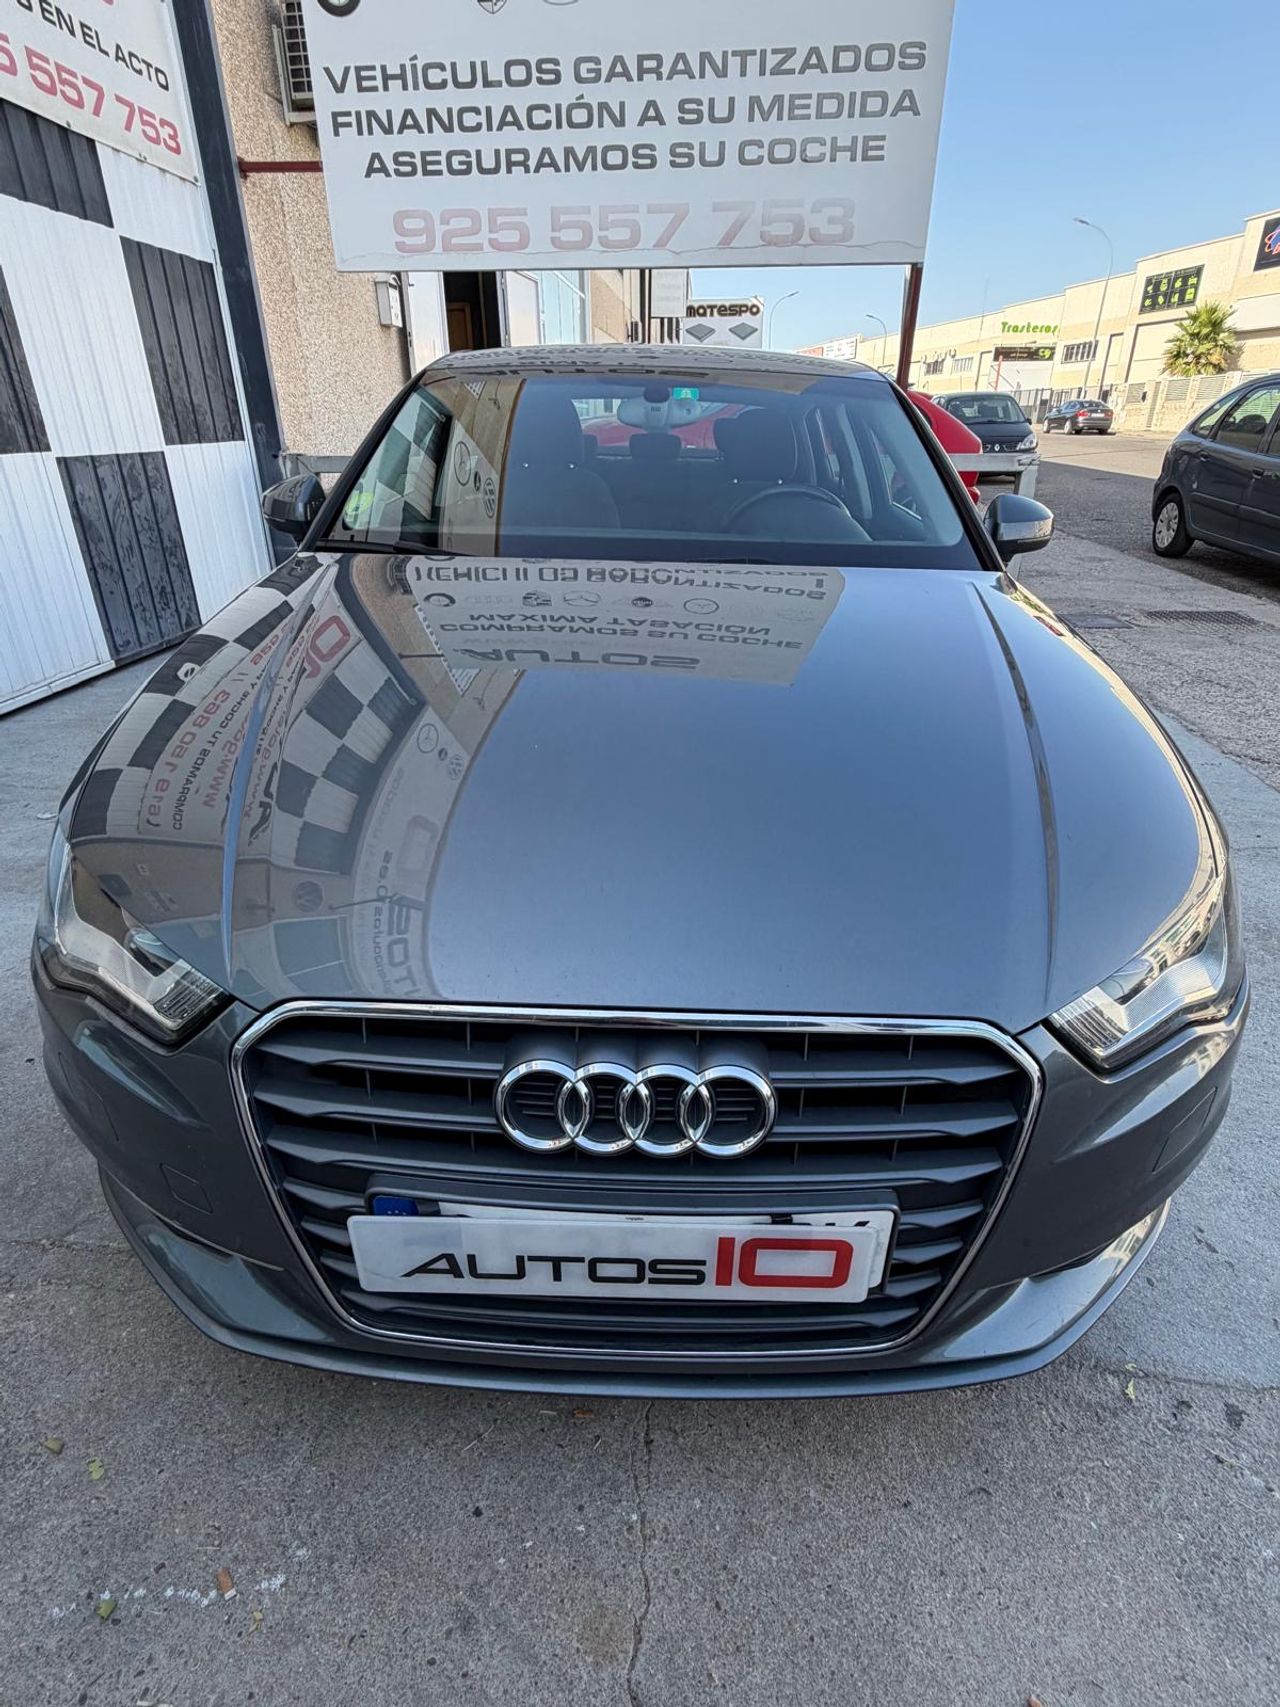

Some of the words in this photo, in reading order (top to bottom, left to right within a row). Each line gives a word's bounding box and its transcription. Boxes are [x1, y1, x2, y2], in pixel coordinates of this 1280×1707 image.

[39, 0, 76, 38] EN
[79, 19, 110, 58] EL
[115, 43, 169, 92] ACTO
[323, 54, 562, 94] VEHÍCULOS
[573, 41, 926, 84] GARANTIZADOS
[24, 44, 105, 117] 557
[114, 93, 182, 155] 753
[330, 93, 627, 137] FINANCIACIÓN
[637, 99, 666, 127] A
[677, 96, 735, 125] SU
[747, 89, 921, 123] MEDIDA
[364, 143, 657, 178] ASEGURAMOS
[669, 141, 726, 169] SU
[738, 135, 887, 167] COCHE
[393, 206, 530, 253] 925
[550, 202, 690, 250] 557
[711, 198, 855, 247] 753
[1001, 321, 1059, 334] Trasteros
